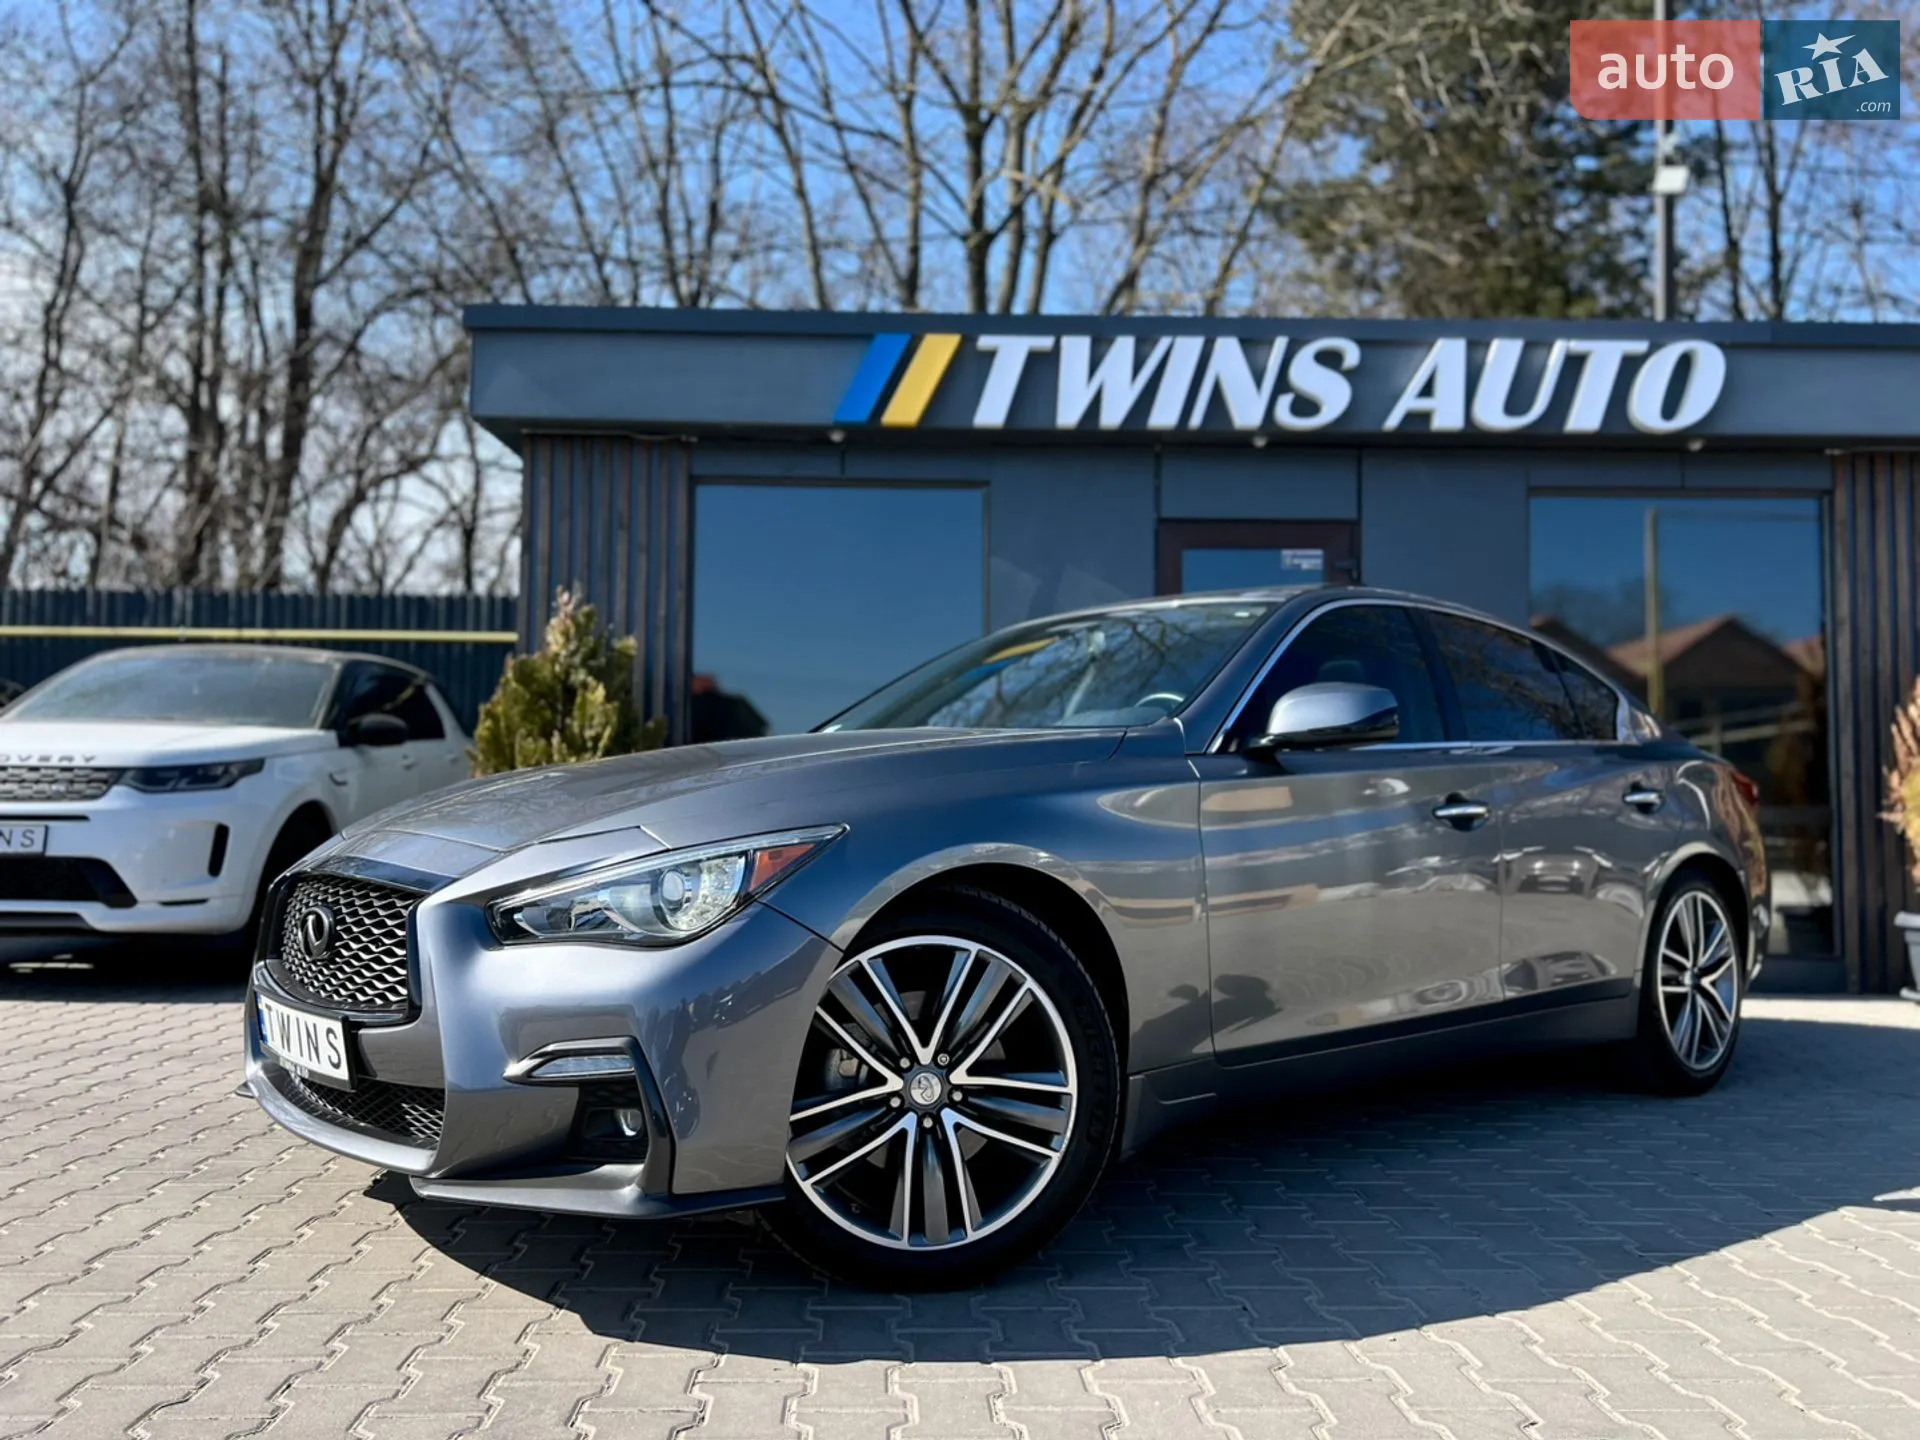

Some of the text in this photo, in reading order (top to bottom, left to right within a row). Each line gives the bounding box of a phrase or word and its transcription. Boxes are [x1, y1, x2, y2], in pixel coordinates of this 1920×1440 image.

[972, 335, 1727, 435] TWINS AUTO
[264, 1003, 342, 1070] TWINS
